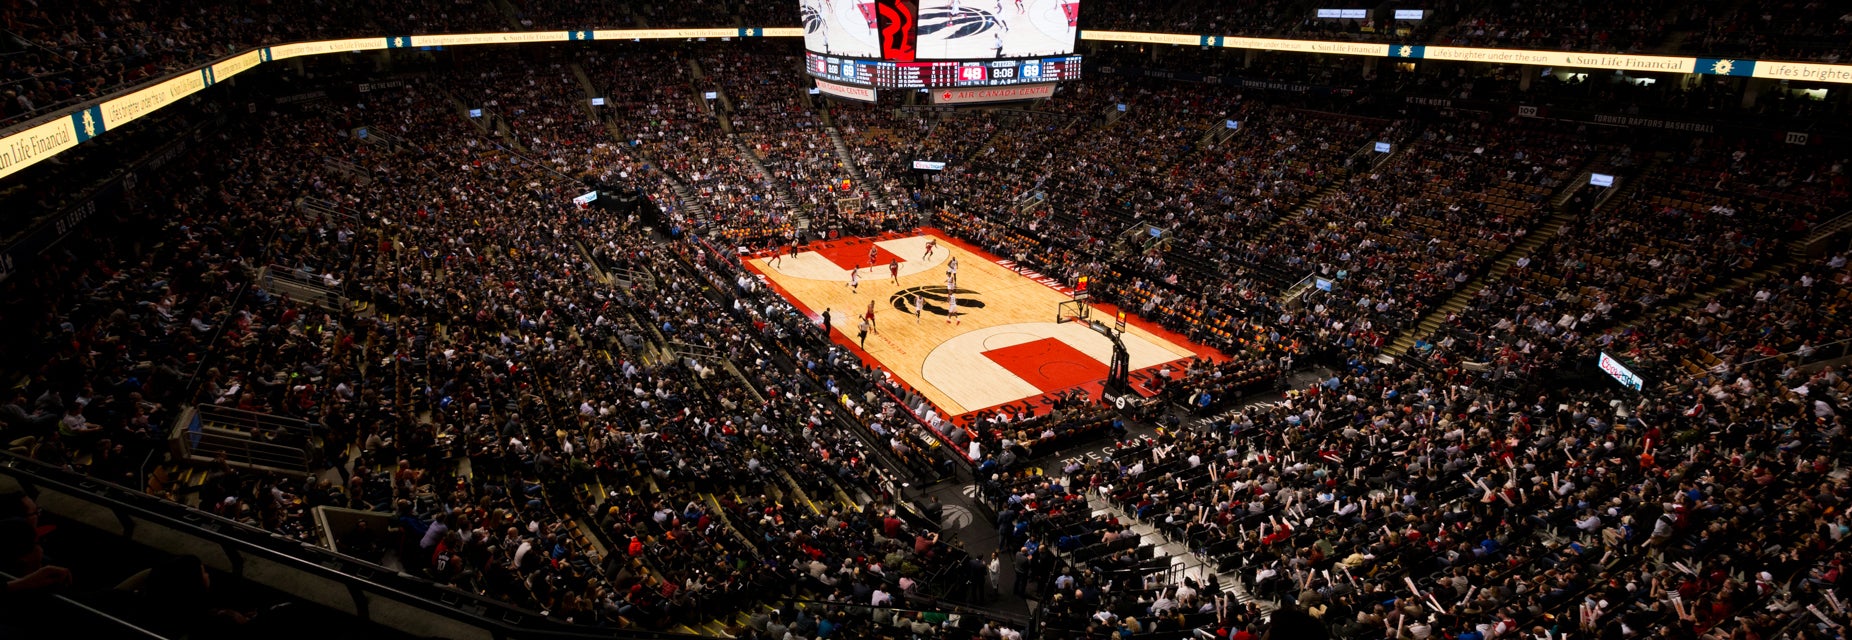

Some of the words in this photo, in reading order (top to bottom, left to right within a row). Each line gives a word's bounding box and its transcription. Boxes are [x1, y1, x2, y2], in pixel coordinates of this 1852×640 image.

[1318, 43, 1332, 51] Sun
[1333, 43, 1346, 52] Life
[1347, 44, 1382, 55] Financial
[1433, 48, 1453, 58] Life's
[1454, 49, 1486, 61] brighter
[1488, 51, 1513, 61] under
[1515, 52, 1530, 62] the
[1532, 55, 1548, 63] sun
[992, 60, 1016, 68] CITIZEN
[1576, 56, 1598, 66] Sun
[1601, 56, 1623, 67] Life
[1625, 57, 1683, 70] Financial
[843, 64, 854, 77] 69
[963, 67, 982, 80] 48
[993, 68, 1014, 78] 8:08
[1023, 65, 1039, 77] 69
[1768, 65, 1799, 77] Life's
[1803, 66, 1852, 81] brighte
[1242, 79, 1267, 89] TORONTO
[1268, 82, 1289, 91] MAPLE
[957, 90, 974, 99] AIR
[978, 88, 1017, 98] CANADA
[1019, 86, 1048, 95] CENTRE
[1415, 96, 1428, 104] THE
[1429, 98, 1452, 107] NORTH
[1520, 106, 1535, 114] 109
[1592, 113, 1627, 126] TORONTO
[1628, 116, 1664, 129] RAPTORS
[1665, 121, 1715, 134] BASKETBALL
[1788, 133, 1807, 144] 110
[0, 151, 12, 170] un
[10, 137, 31, 164] Life
[30, 122, 71, 156] Financial
[66, 206, 88, 228] LEAFS
[1104, 392, 1116, 403] BMO
